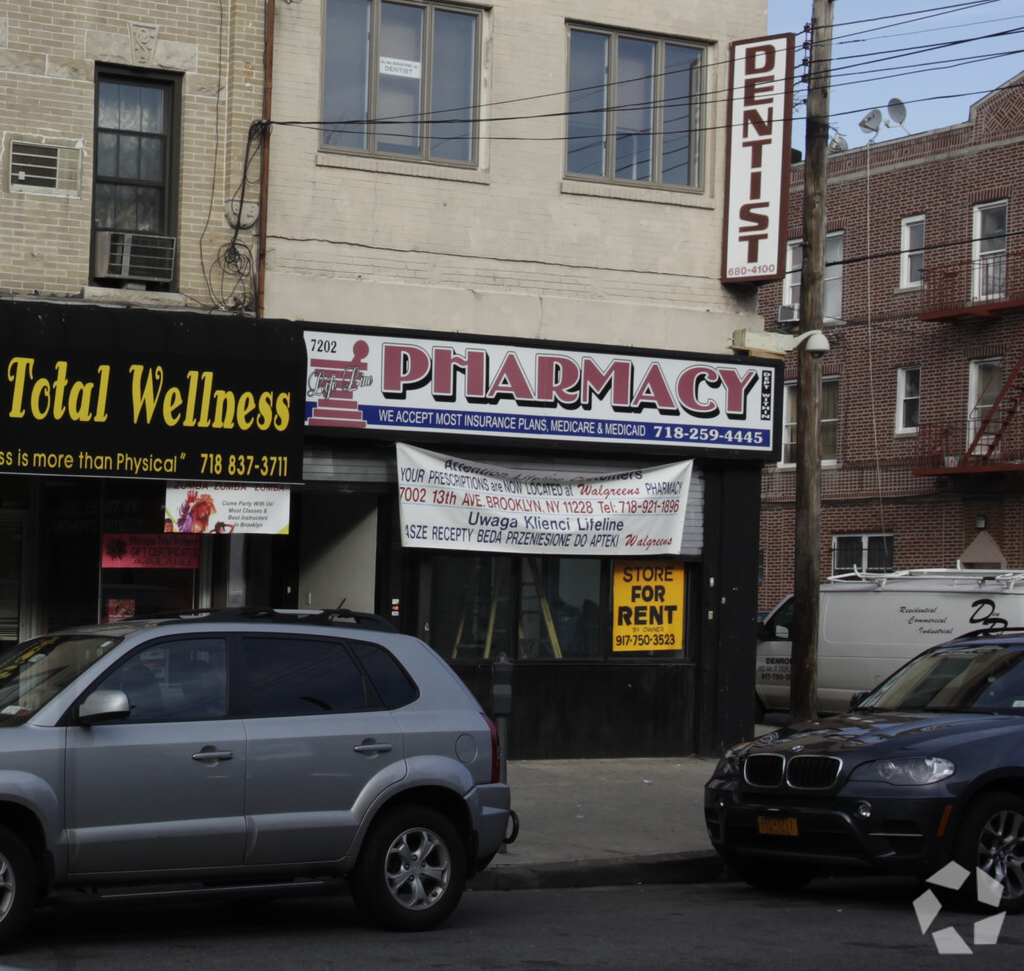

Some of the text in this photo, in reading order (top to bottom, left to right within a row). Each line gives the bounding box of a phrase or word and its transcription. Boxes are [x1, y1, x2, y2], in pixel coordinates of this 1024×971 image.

[738, 44, 776, 264] DENTIST
[728, 264, 776, 276] 680-4100
[310, 339, 337, 353] 7202
[381, 342, 760, 421] PHARMACY
[7, 356, 111, 422] Total
[128, 364, 291, 432] Wellness
[378, 409, 763, 445] WE ACCEPT MOST INSURANCE PLANS, MEDICARE & MEDICAID 718-259-4445
[17, 449, 29, 466] is
[33, 452, 74, 469] more
[78, 451, 113, 470] than
[200, 453, 288, 477] 718 837-3711
[401, 467, 684, 500] YOUR PRESCRIPTIONS are NOW LOCATED at Walgreens PHARMACY
[400, 486, 426, 503] 7002
[432, 490, 457, 505] 13th
[461, 493, 486, 508] AVE.
[546, 501, 560, 514] NY
[563, 500, 594, 515] 11228
[597, 501, 618, 514] Tel:
[619, 499, 680, 514] 718-921-1896
[468, 511, 625, 532] Uwaga Klienci Lifeline
[432, 526, 474, 542] RECEPTY
[477, 529, 502, 544] BEDA
[506, 530, 573, 547] PRZENIESIONE
[574, 533, 588, 547] DO
[590, 533, 620, 548] APTEKI
[625, 533, 673, 551] Walgreens
[149, 547, 198, 558] CERTIFICATES
[623, 566, 674, 582] STORE
[631, 585, 666, 602] FOR
[617, 605, 677, 626] RENT
[899, 606, 937, 614] Residential
[908, 616, 947, 624] Commercial
